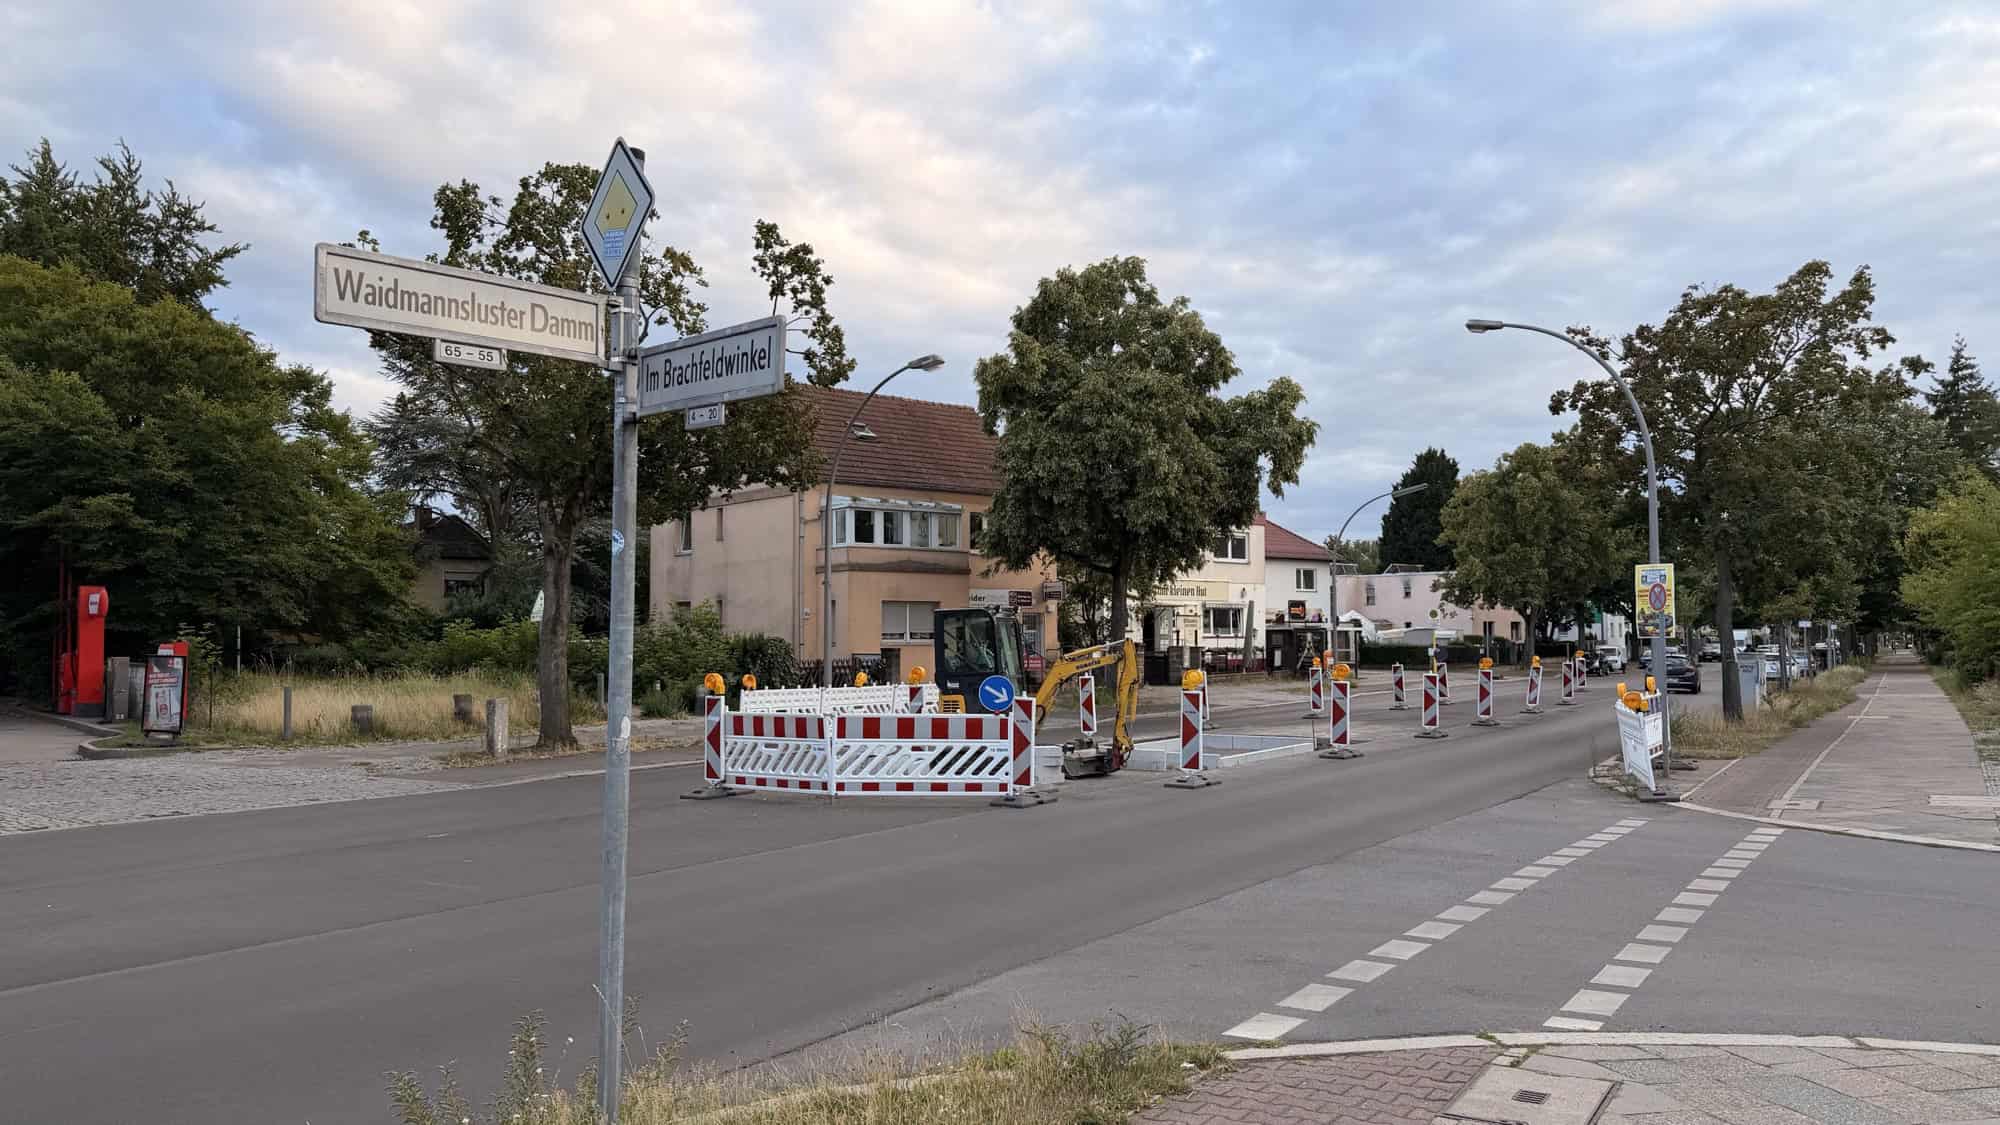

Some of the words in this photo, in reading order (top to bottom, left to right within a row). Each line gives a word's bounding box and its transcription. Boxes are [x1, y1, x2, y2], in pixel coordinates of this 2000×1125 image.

[334, 267, 526, 331] Waidmannsluster
[530, 302, 594, 342] Damm
[444, 345, 461, 358] 65
[478, 350, 494, 362] 55
[646, 363, 659, 392] Im
[663, 335, 772, 389] Brachfeldwinkel
[708, 407, 718, 420] 20
